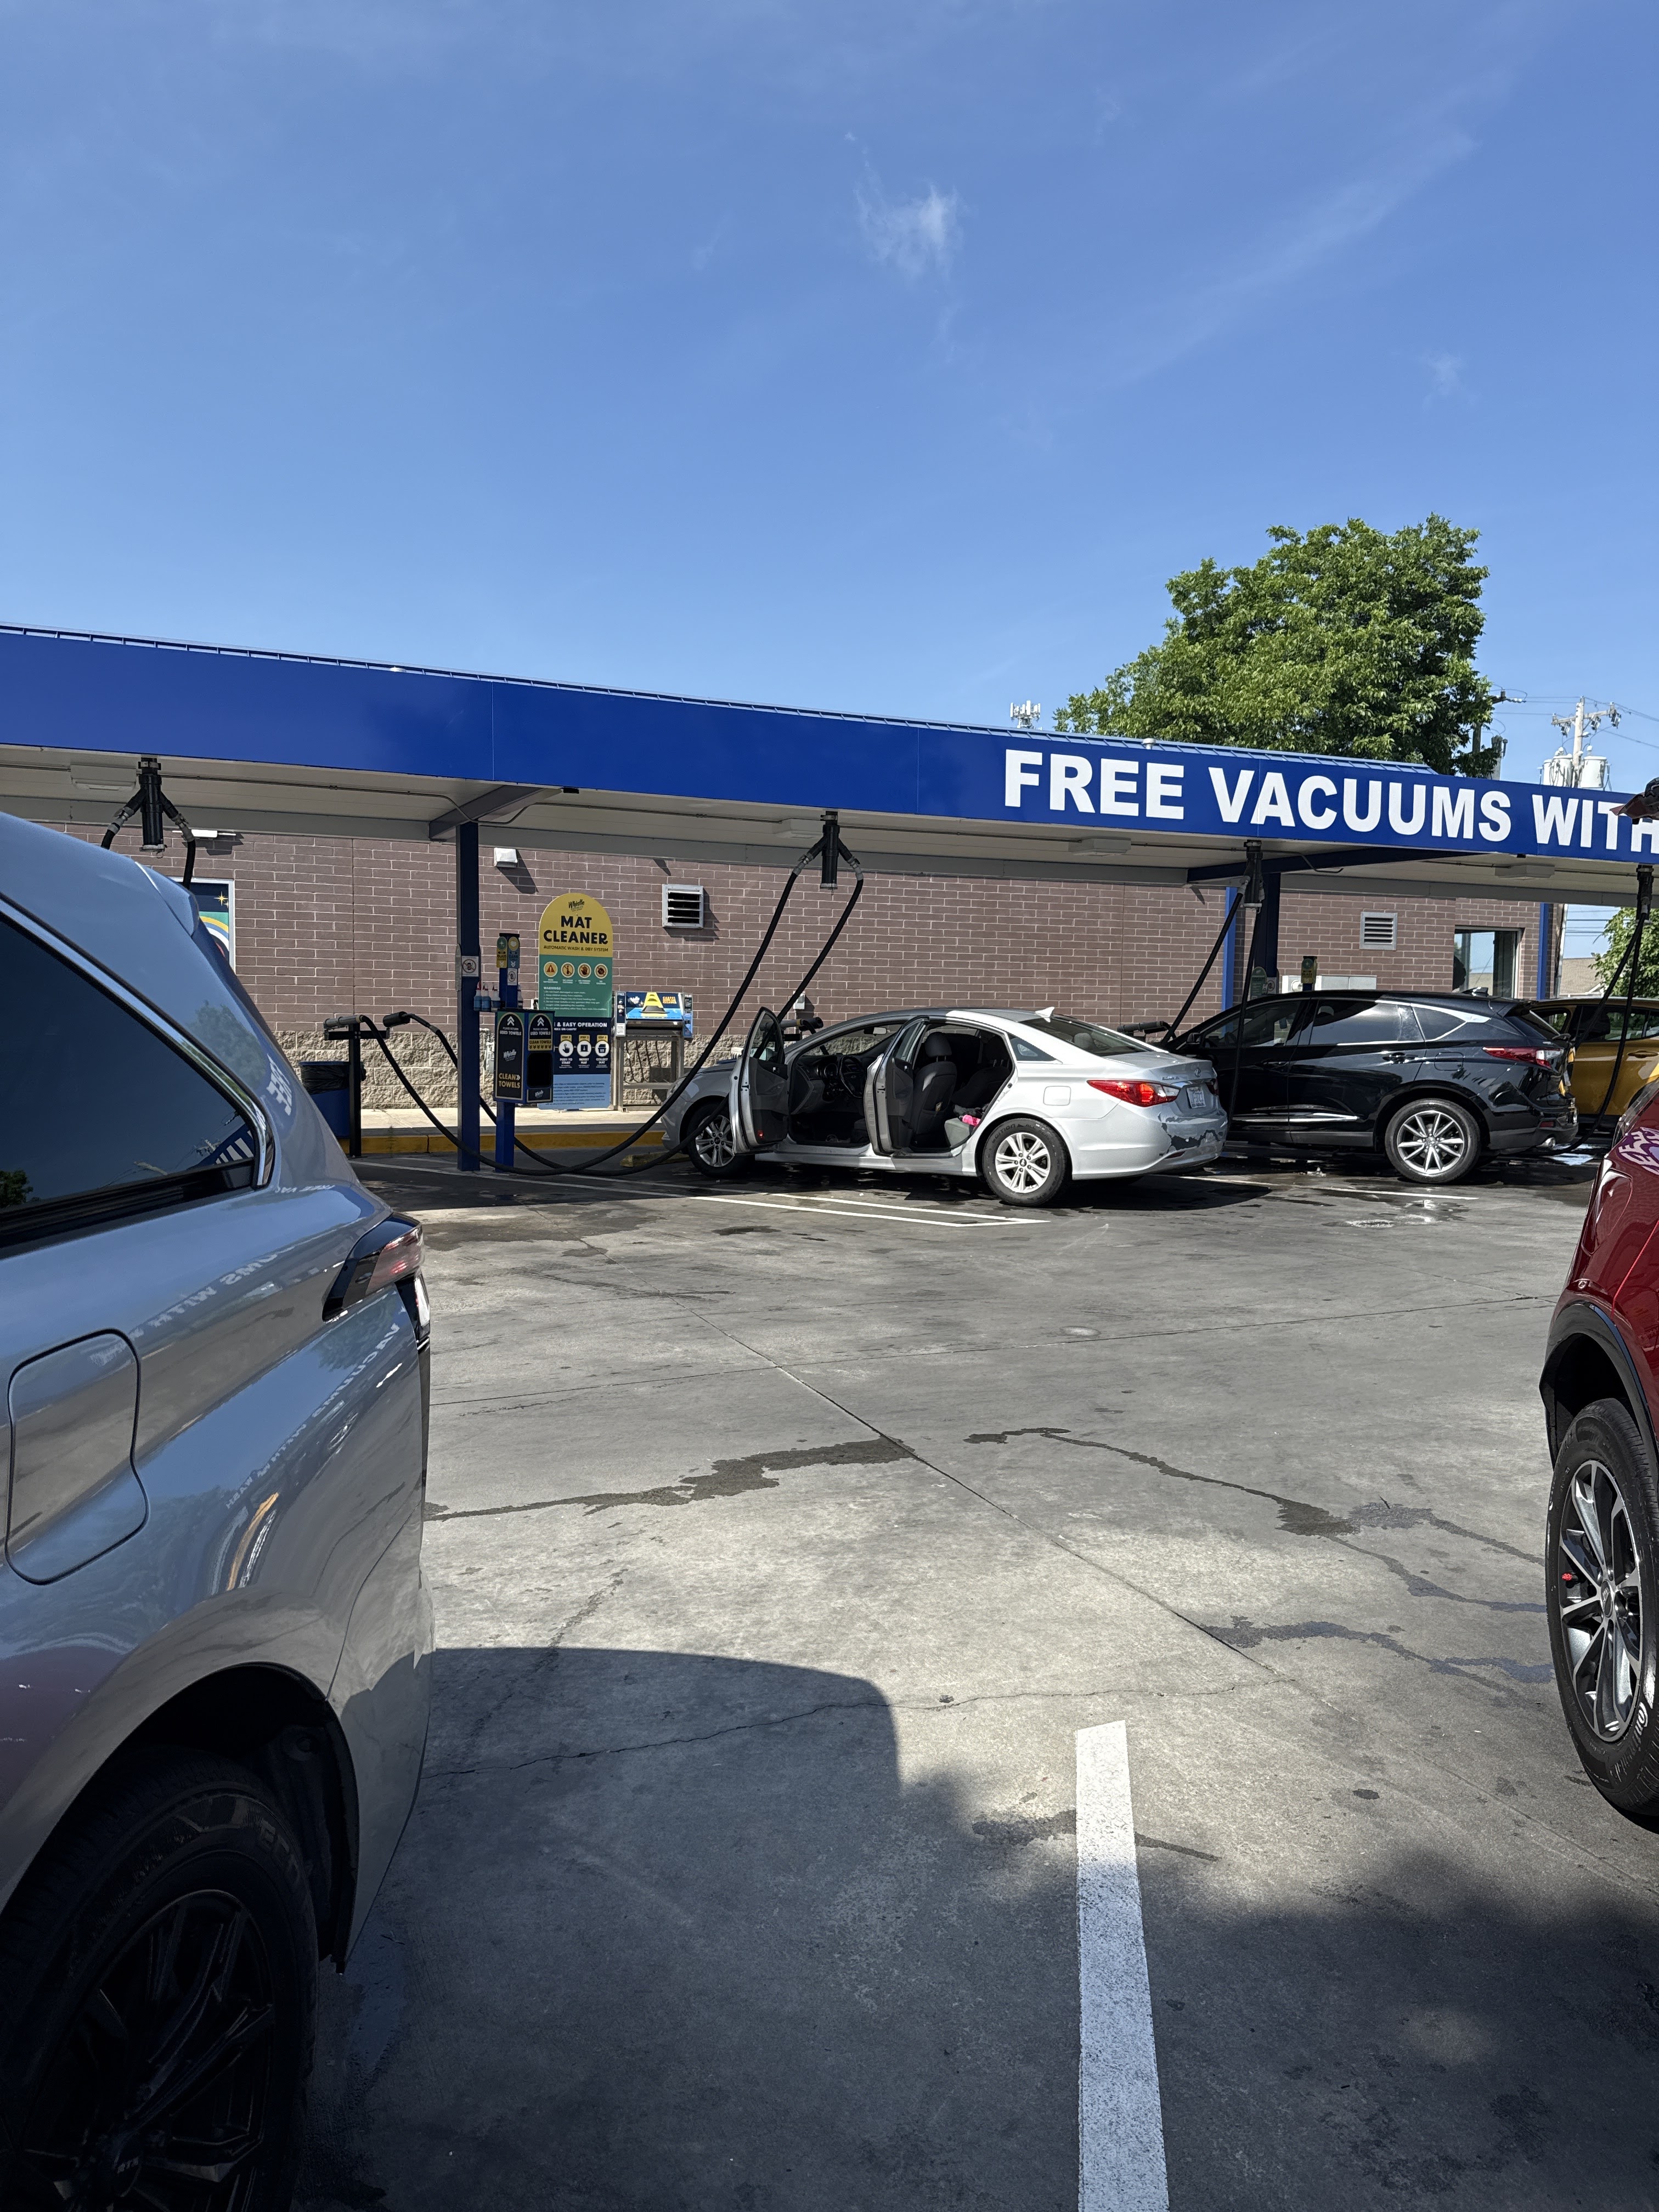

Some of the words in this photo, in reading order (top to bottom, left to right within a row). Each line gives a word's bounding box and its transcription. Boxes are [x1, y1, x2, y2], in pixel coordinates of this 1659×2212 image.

[1005, 749, 1184, 820] FREE
[1208, 767, 1512, 842] VACUUMS
[561, 915, 592, 928] MAT
[543, 929, 608, 945] CLEANER
[498, 1081, 521, 1089] TOWELS
